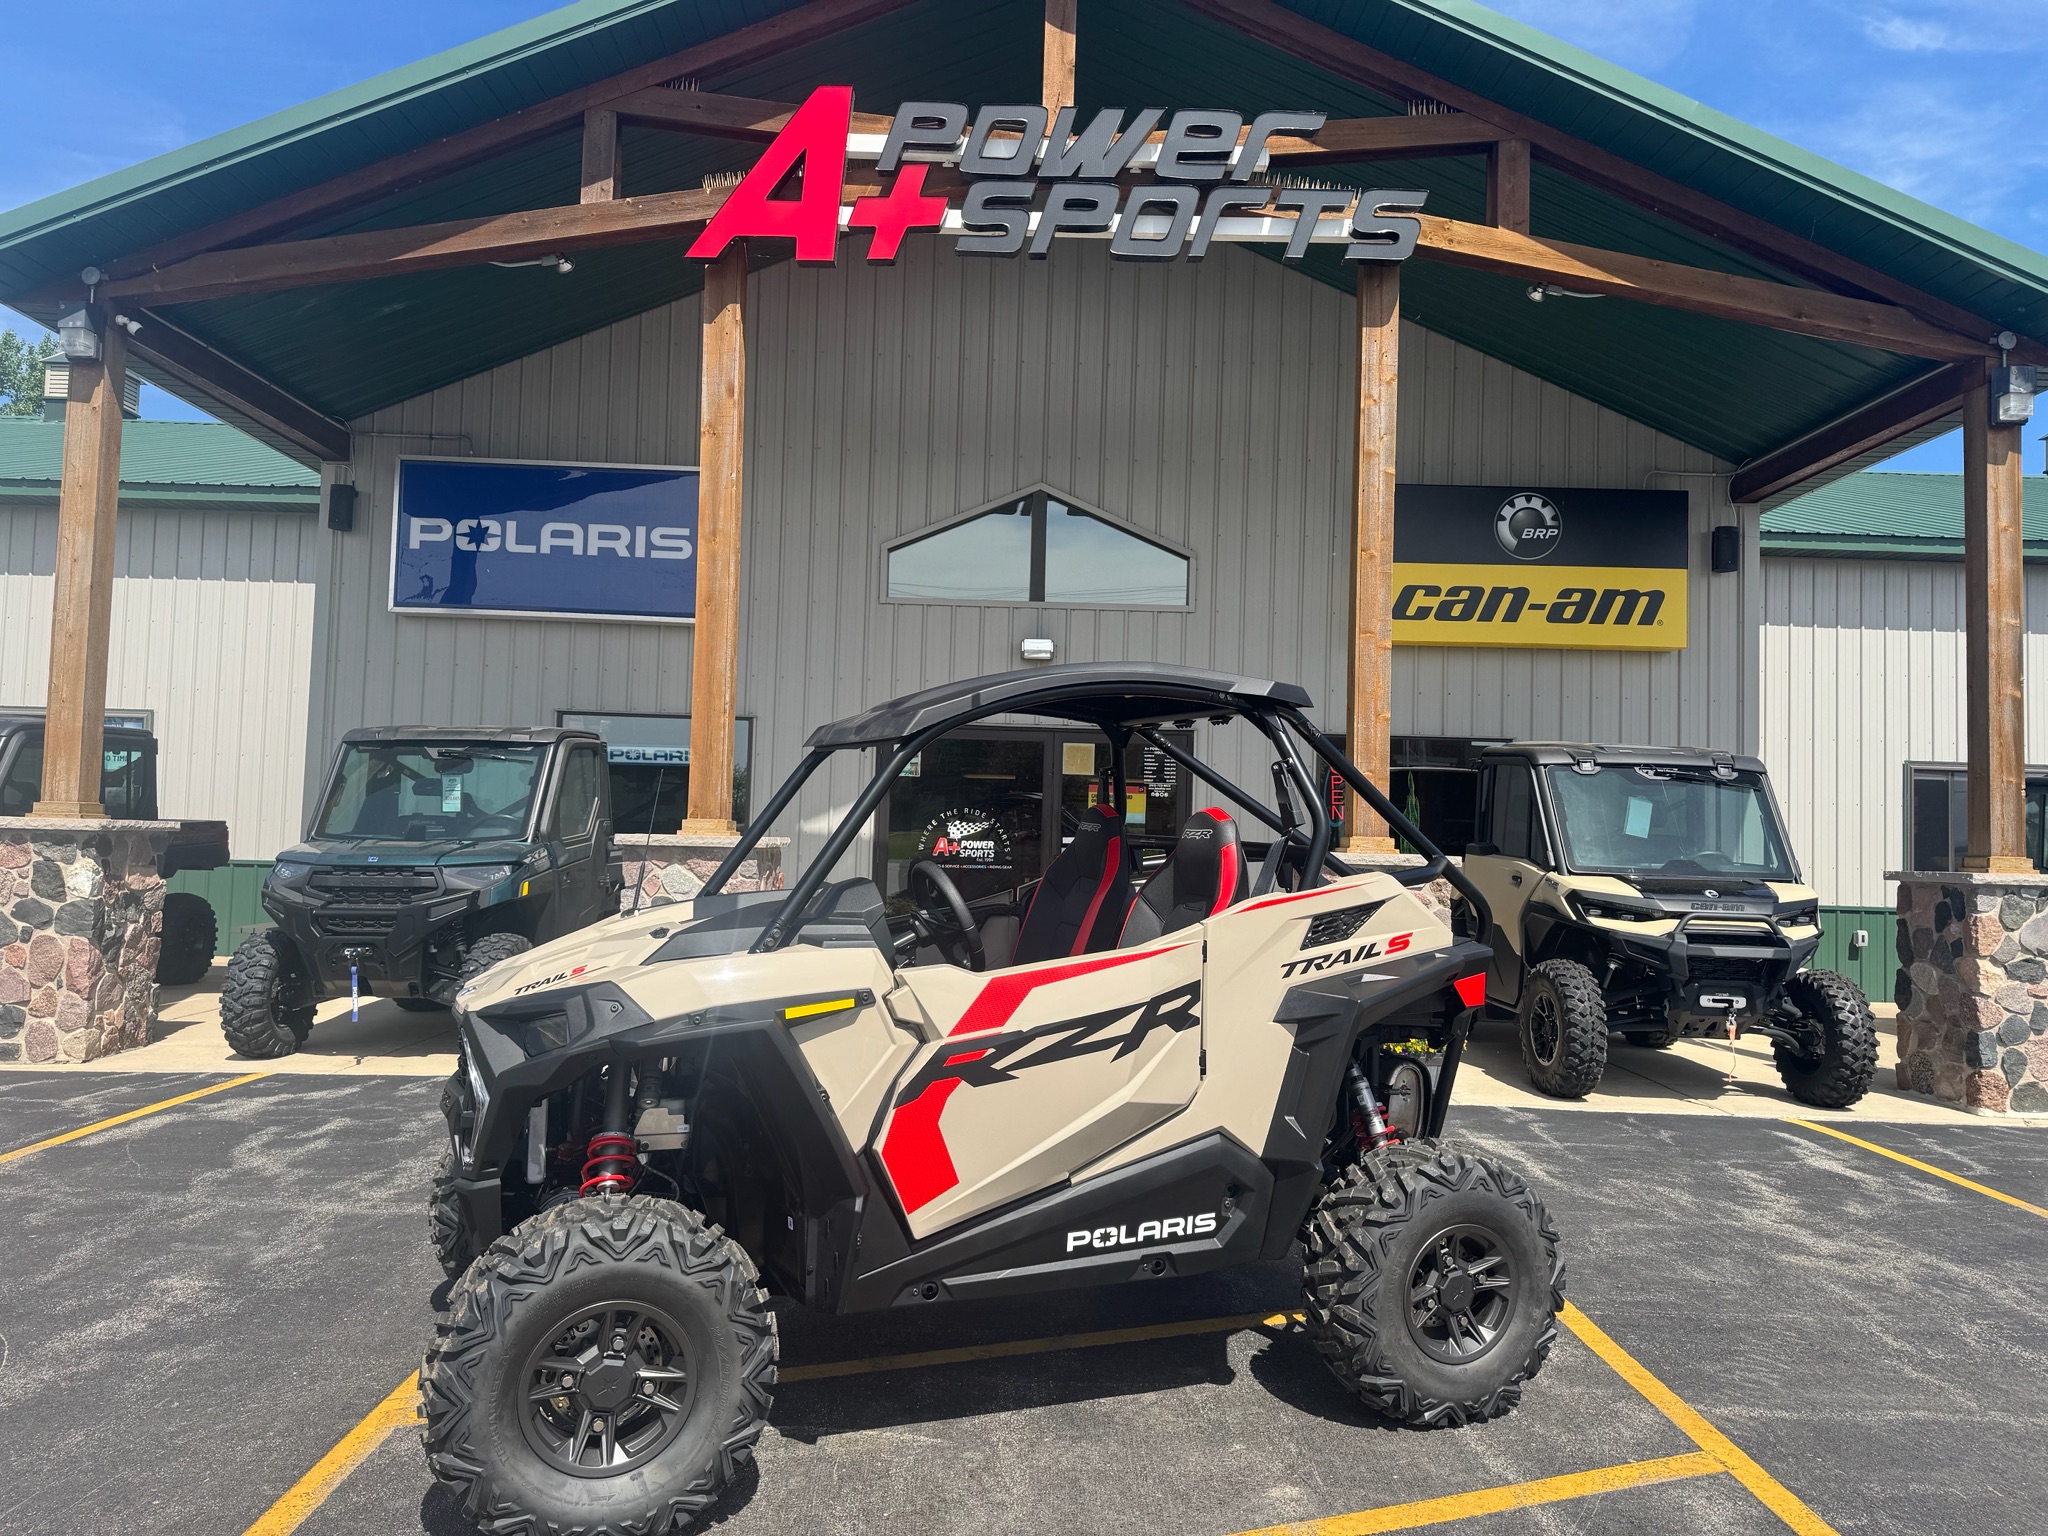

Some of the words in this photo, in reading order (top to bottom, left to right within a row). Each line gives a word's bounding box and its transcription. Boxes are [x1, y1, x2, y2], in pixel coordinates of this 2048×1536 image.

[683, 85, 948, 266] A+
[408, 517, 693, 560] POLARIS
[1521, 528, 1559, 539] BRP
[609, 749, 690, 762] POLARI
[1330, 766, 1346, 820] PEN
[918, 819, 938, 851] WHERE
[940, 808, 958, 820] THE
[963, 807, 987, 819] RIDE
[989, 818, 1011, 853] STARTS
[960, 840, 995, 850] POWER
[1182, 828, 1214, 840] RZR
[959, 849, 995, 858] SPORTS
[1280, 942, 1382, 980] TRAIL
[1384, 932, 1414, 956] S
[514, 972, 568, 996] TRAIL
[569, 964, 589, 977] S
[894, 978, 1201, 1110] RZR
[1066, 1212, 1217, 1253] POLARIS
